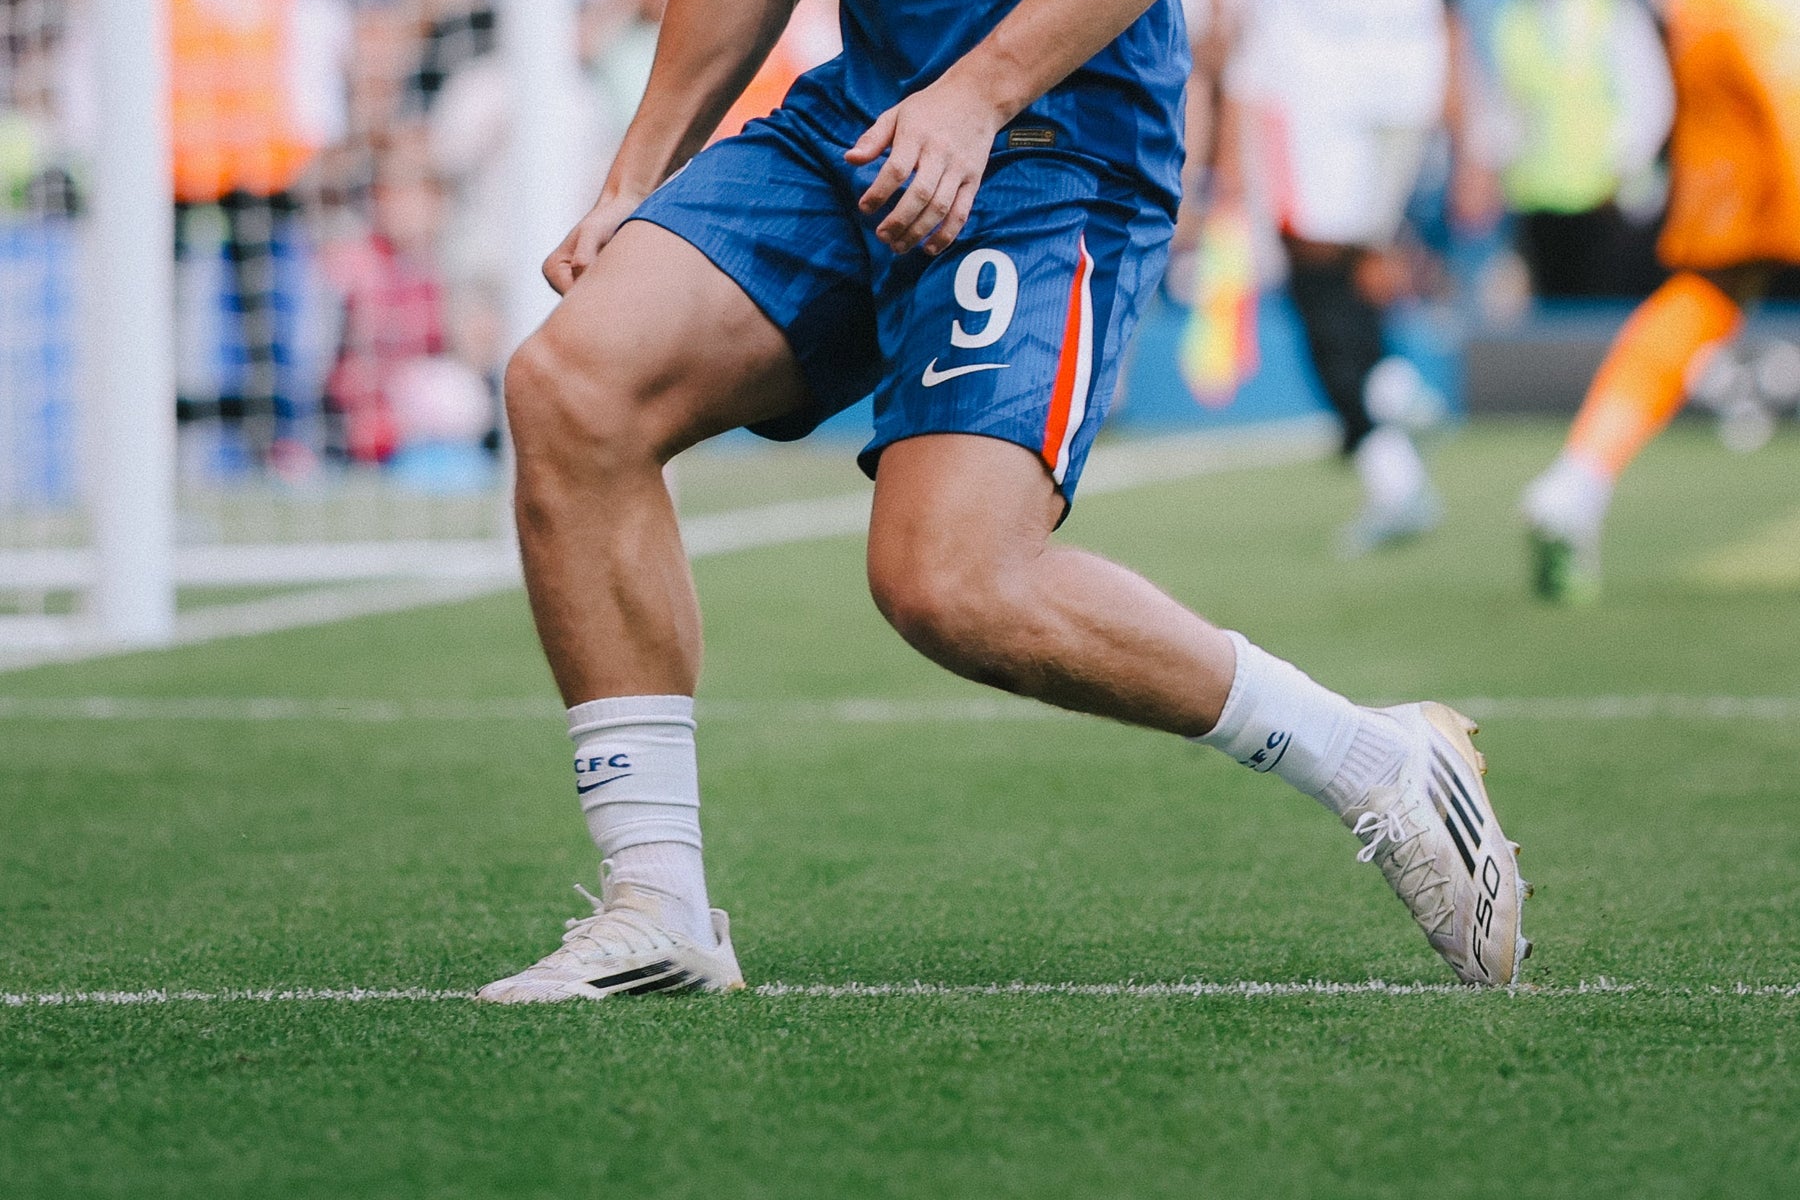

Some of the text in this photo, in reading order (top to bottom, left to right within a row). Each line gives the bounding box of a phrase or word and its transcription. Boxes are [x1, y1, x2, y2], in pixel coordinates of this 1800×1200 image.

[950, 248, 1019, 349] 9
[574, 753, 632, 774] CFC
[1472, 854, 1501, 978] F50
